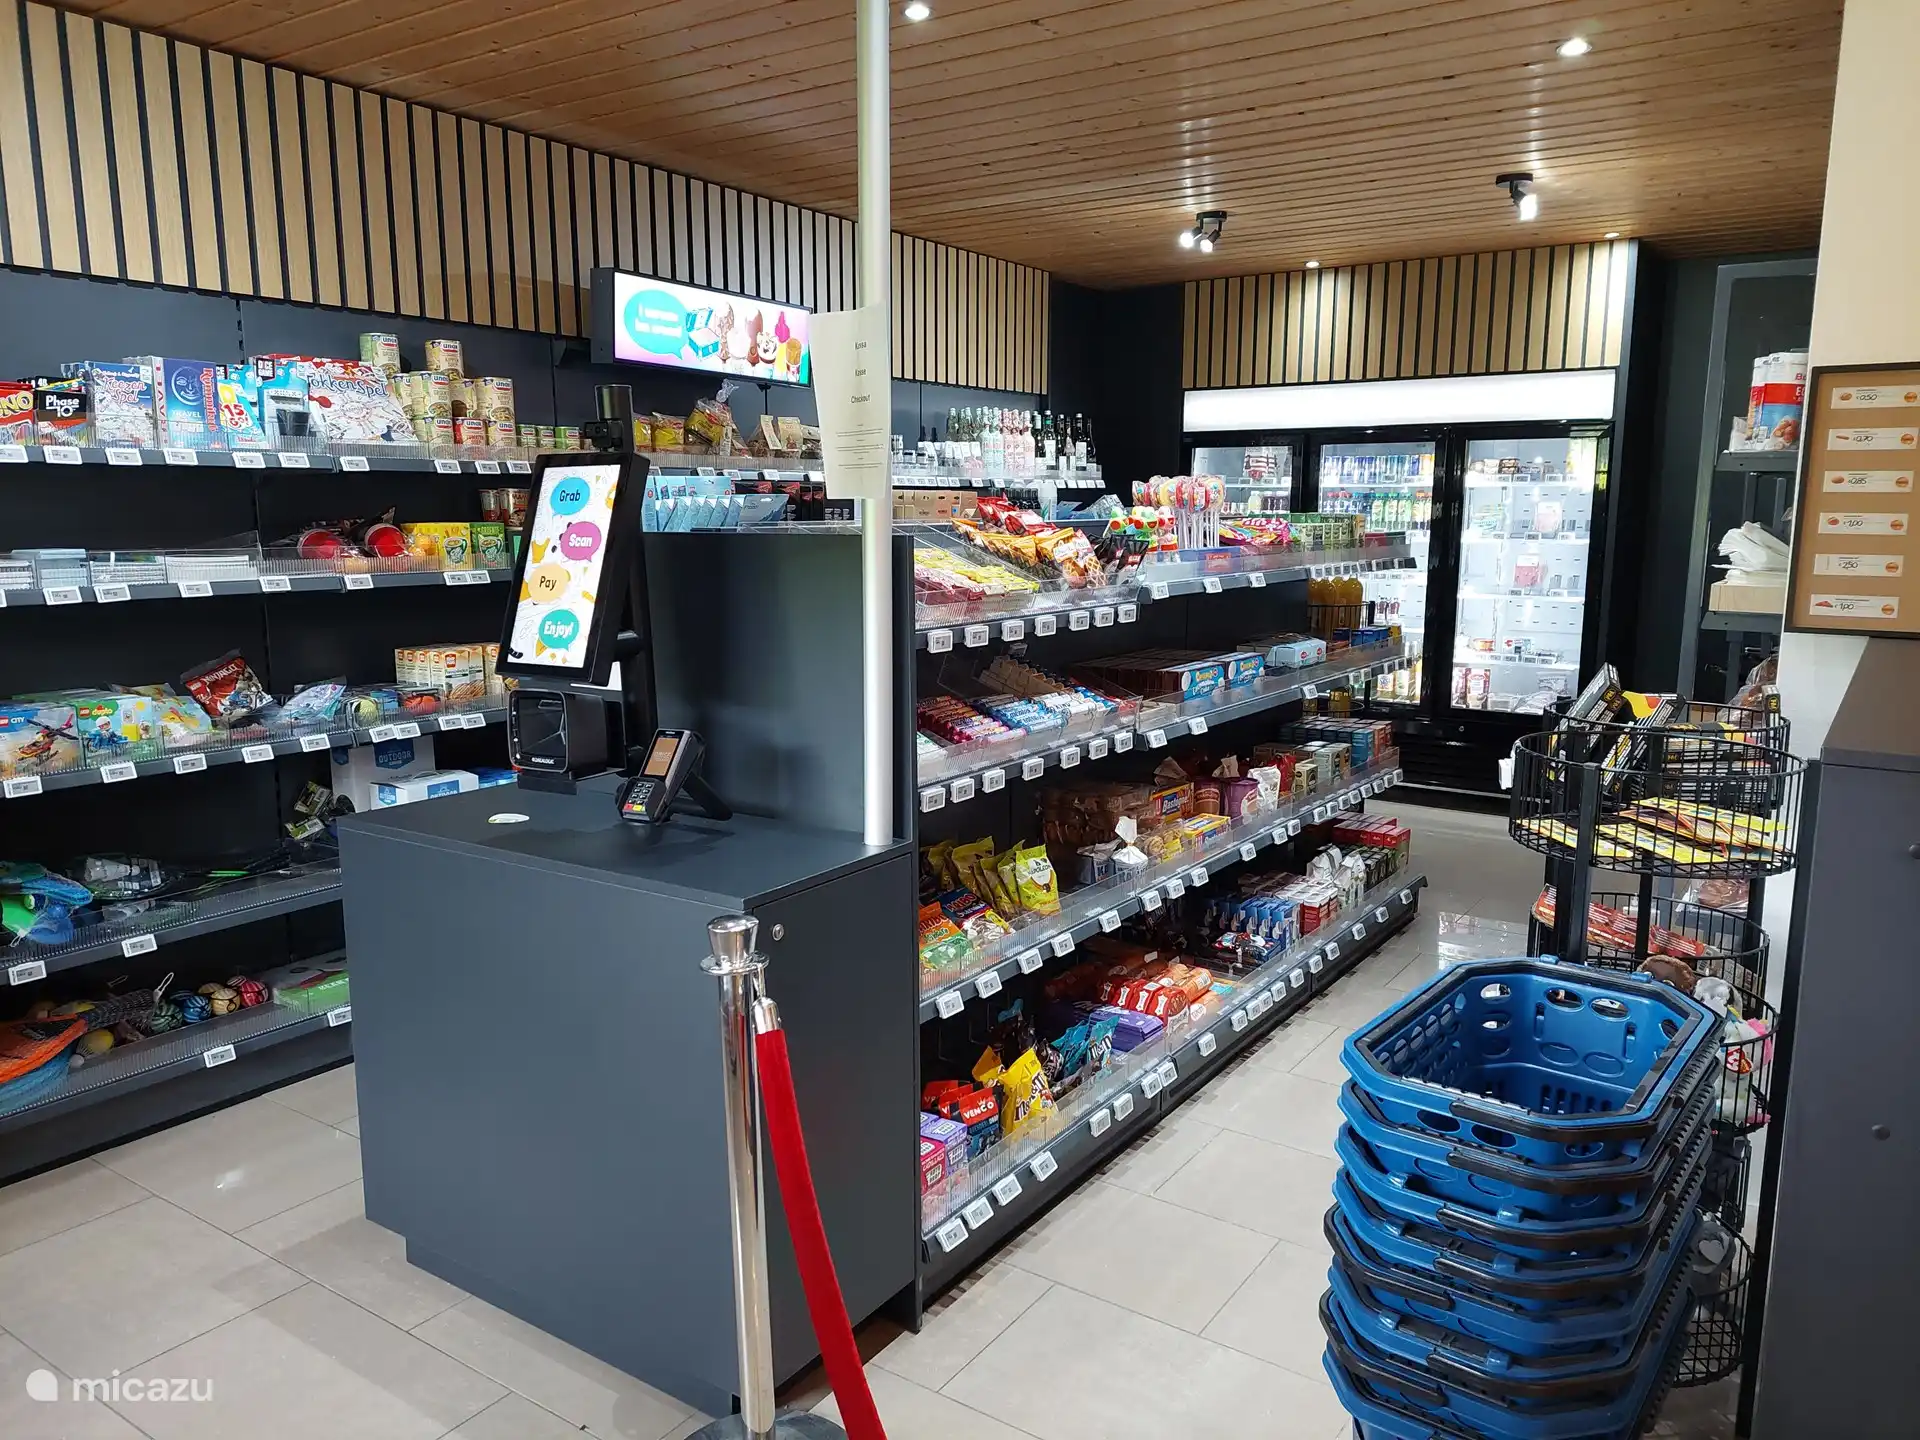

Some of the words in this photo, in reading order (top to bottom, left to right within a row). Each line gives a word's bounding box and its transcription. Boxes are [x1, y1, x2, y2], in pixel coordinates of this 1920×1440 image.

[257, 368, 274, 377] GAME
[102, 377, 146, 391] Keezen
[45, 395, 80, 407] Phase
[113, 389, 139, 405] Spel
[850, 394, 871, 404] Checkout
[57, 405, 74, 418] 10
[171, 410, 202, 418] TRAVEL
[223, 403, 245, 417] 15
[559, 489, 581, 502] Grab
[568, 533, 593, 548] Scan
[538, 575, 557, 592] Pay
[543, 620, 574, 639] Enjoy!
[203, 663, 238, 685] NINJAGO
[91, 707, 114, 716] duplo
[10, 716, 26, 724] CITY
[378, 750, 413, 763] OUTDOOR
[1028, 862, 1052, 875] NAPOLEON
[963, 1100, 995, 1120] VENCO
